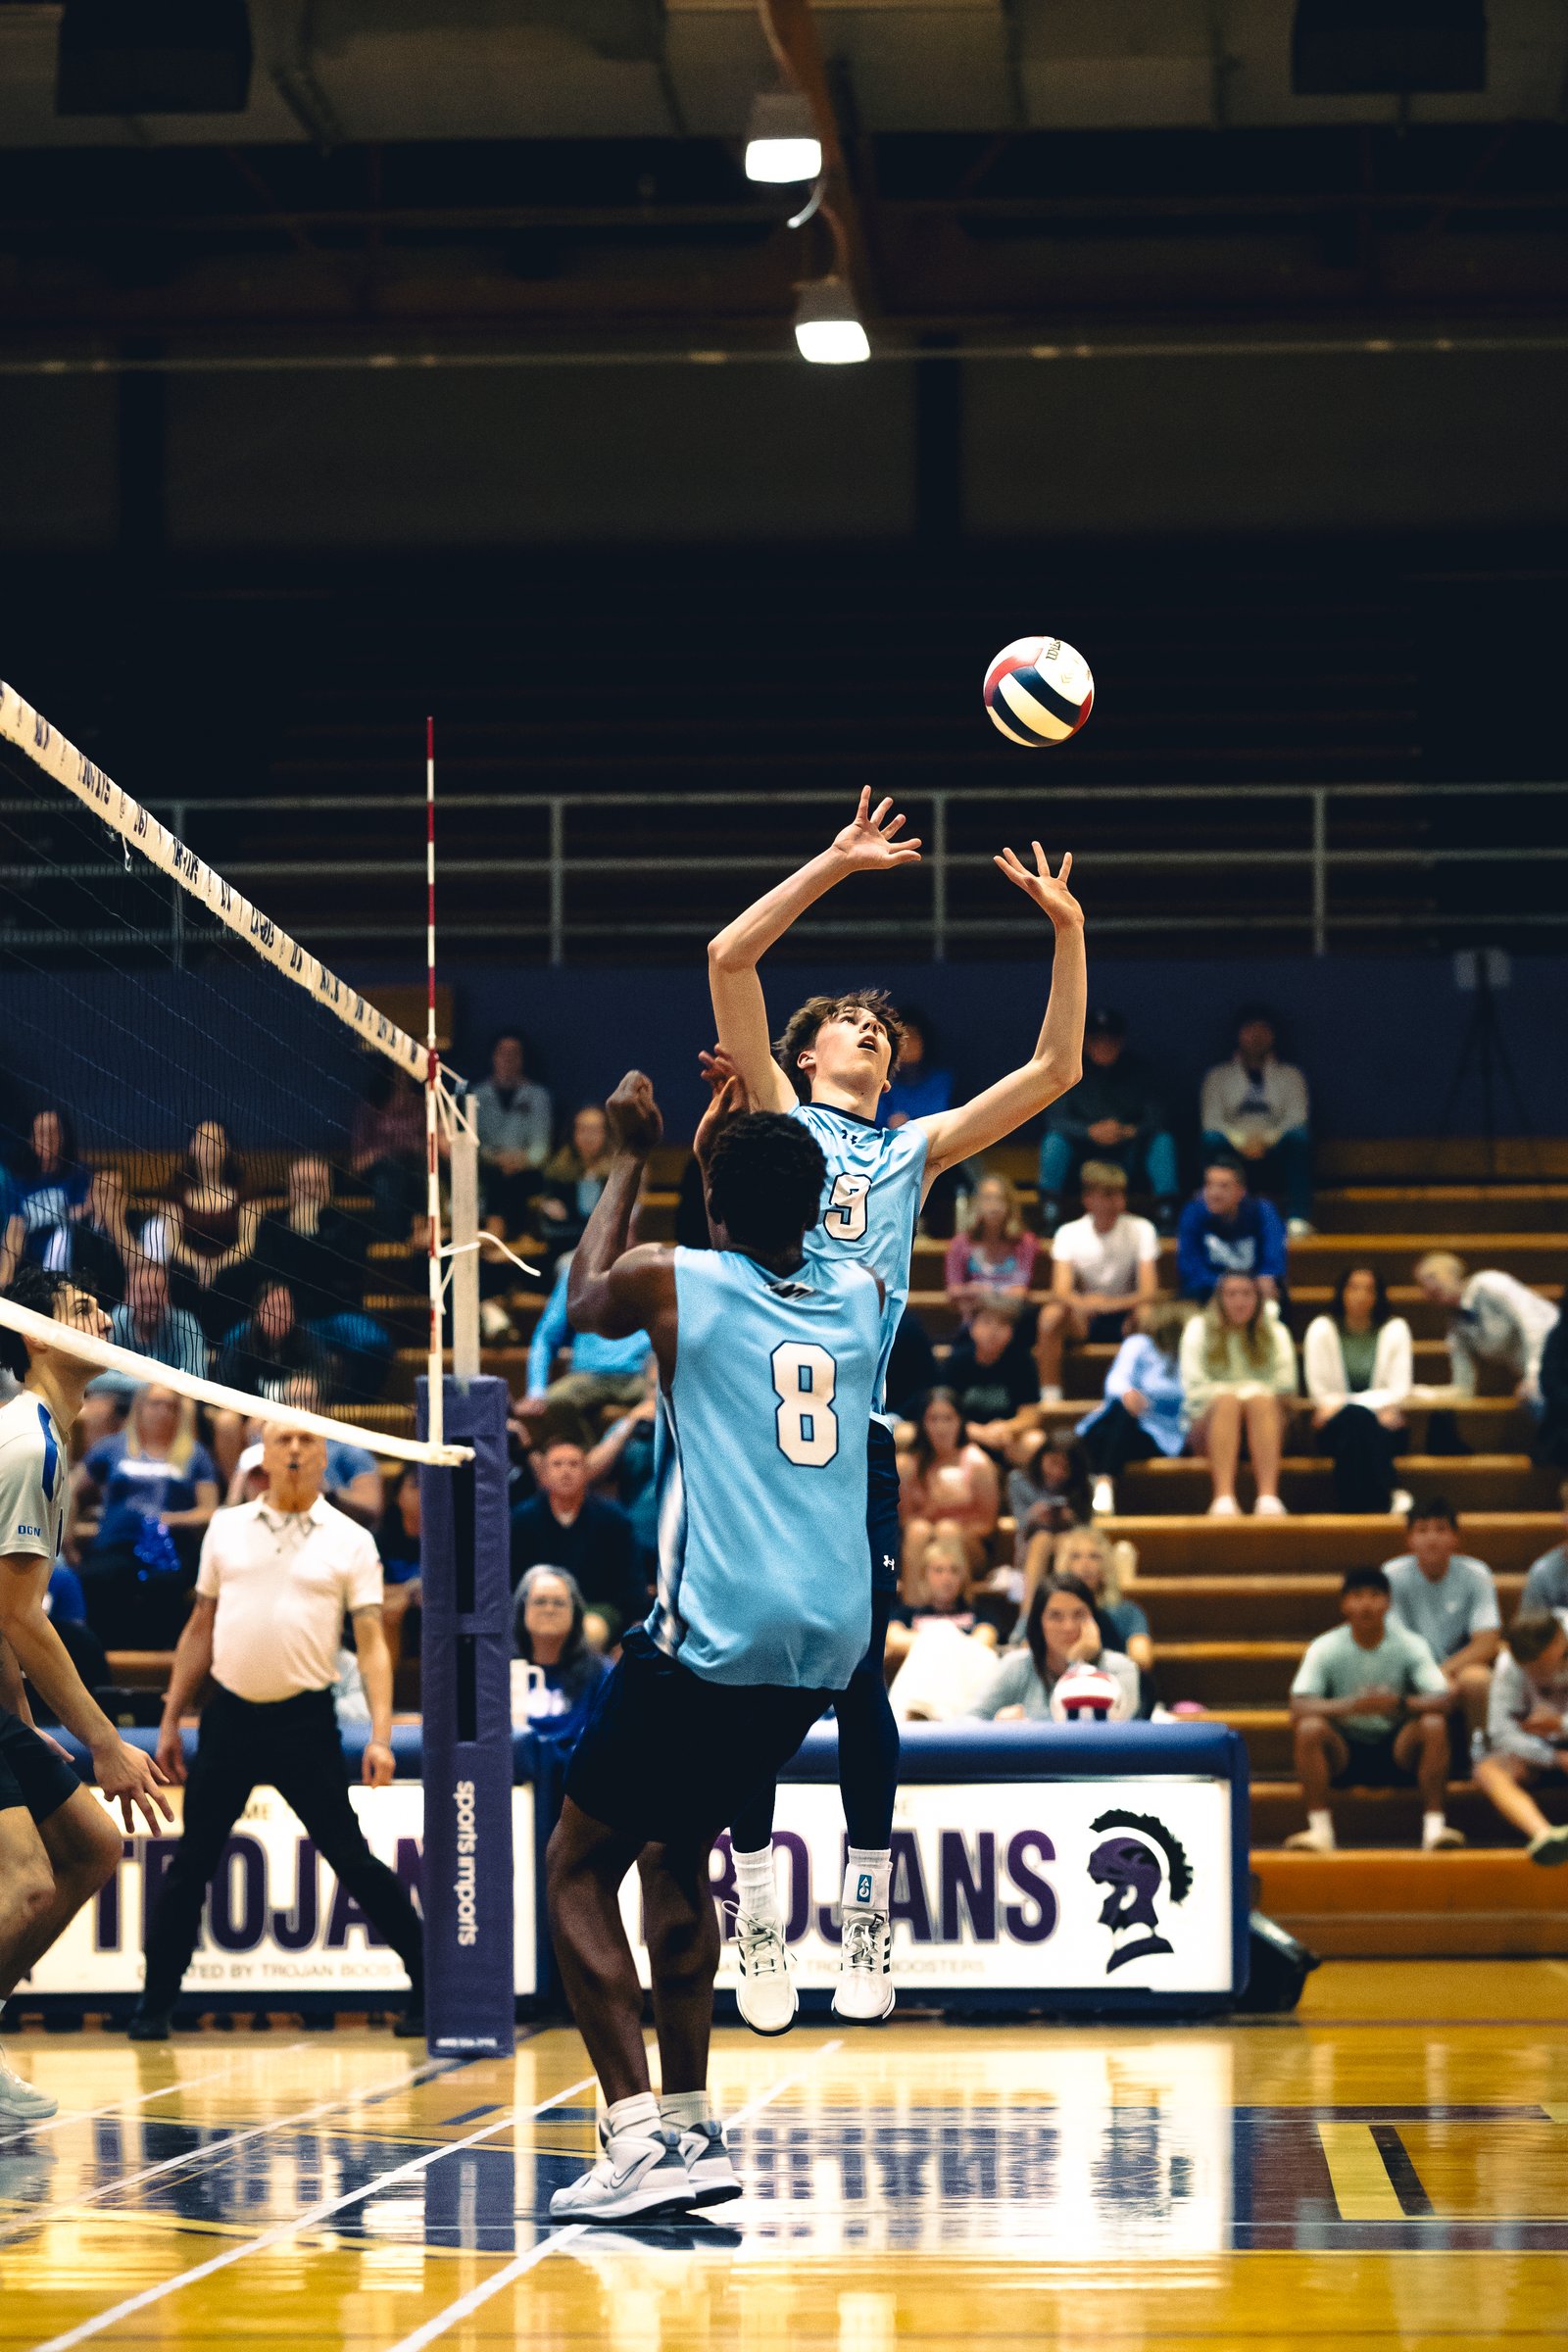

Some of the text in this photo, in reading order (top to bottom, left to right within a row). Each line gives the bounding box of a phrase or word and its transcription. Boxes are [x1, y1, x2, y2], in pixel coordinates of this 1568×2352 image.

[823, 1171, 873, 1242] 9
[770, 1340, 840, 1468] 8
[453, 1780, 478, 1854] sports
